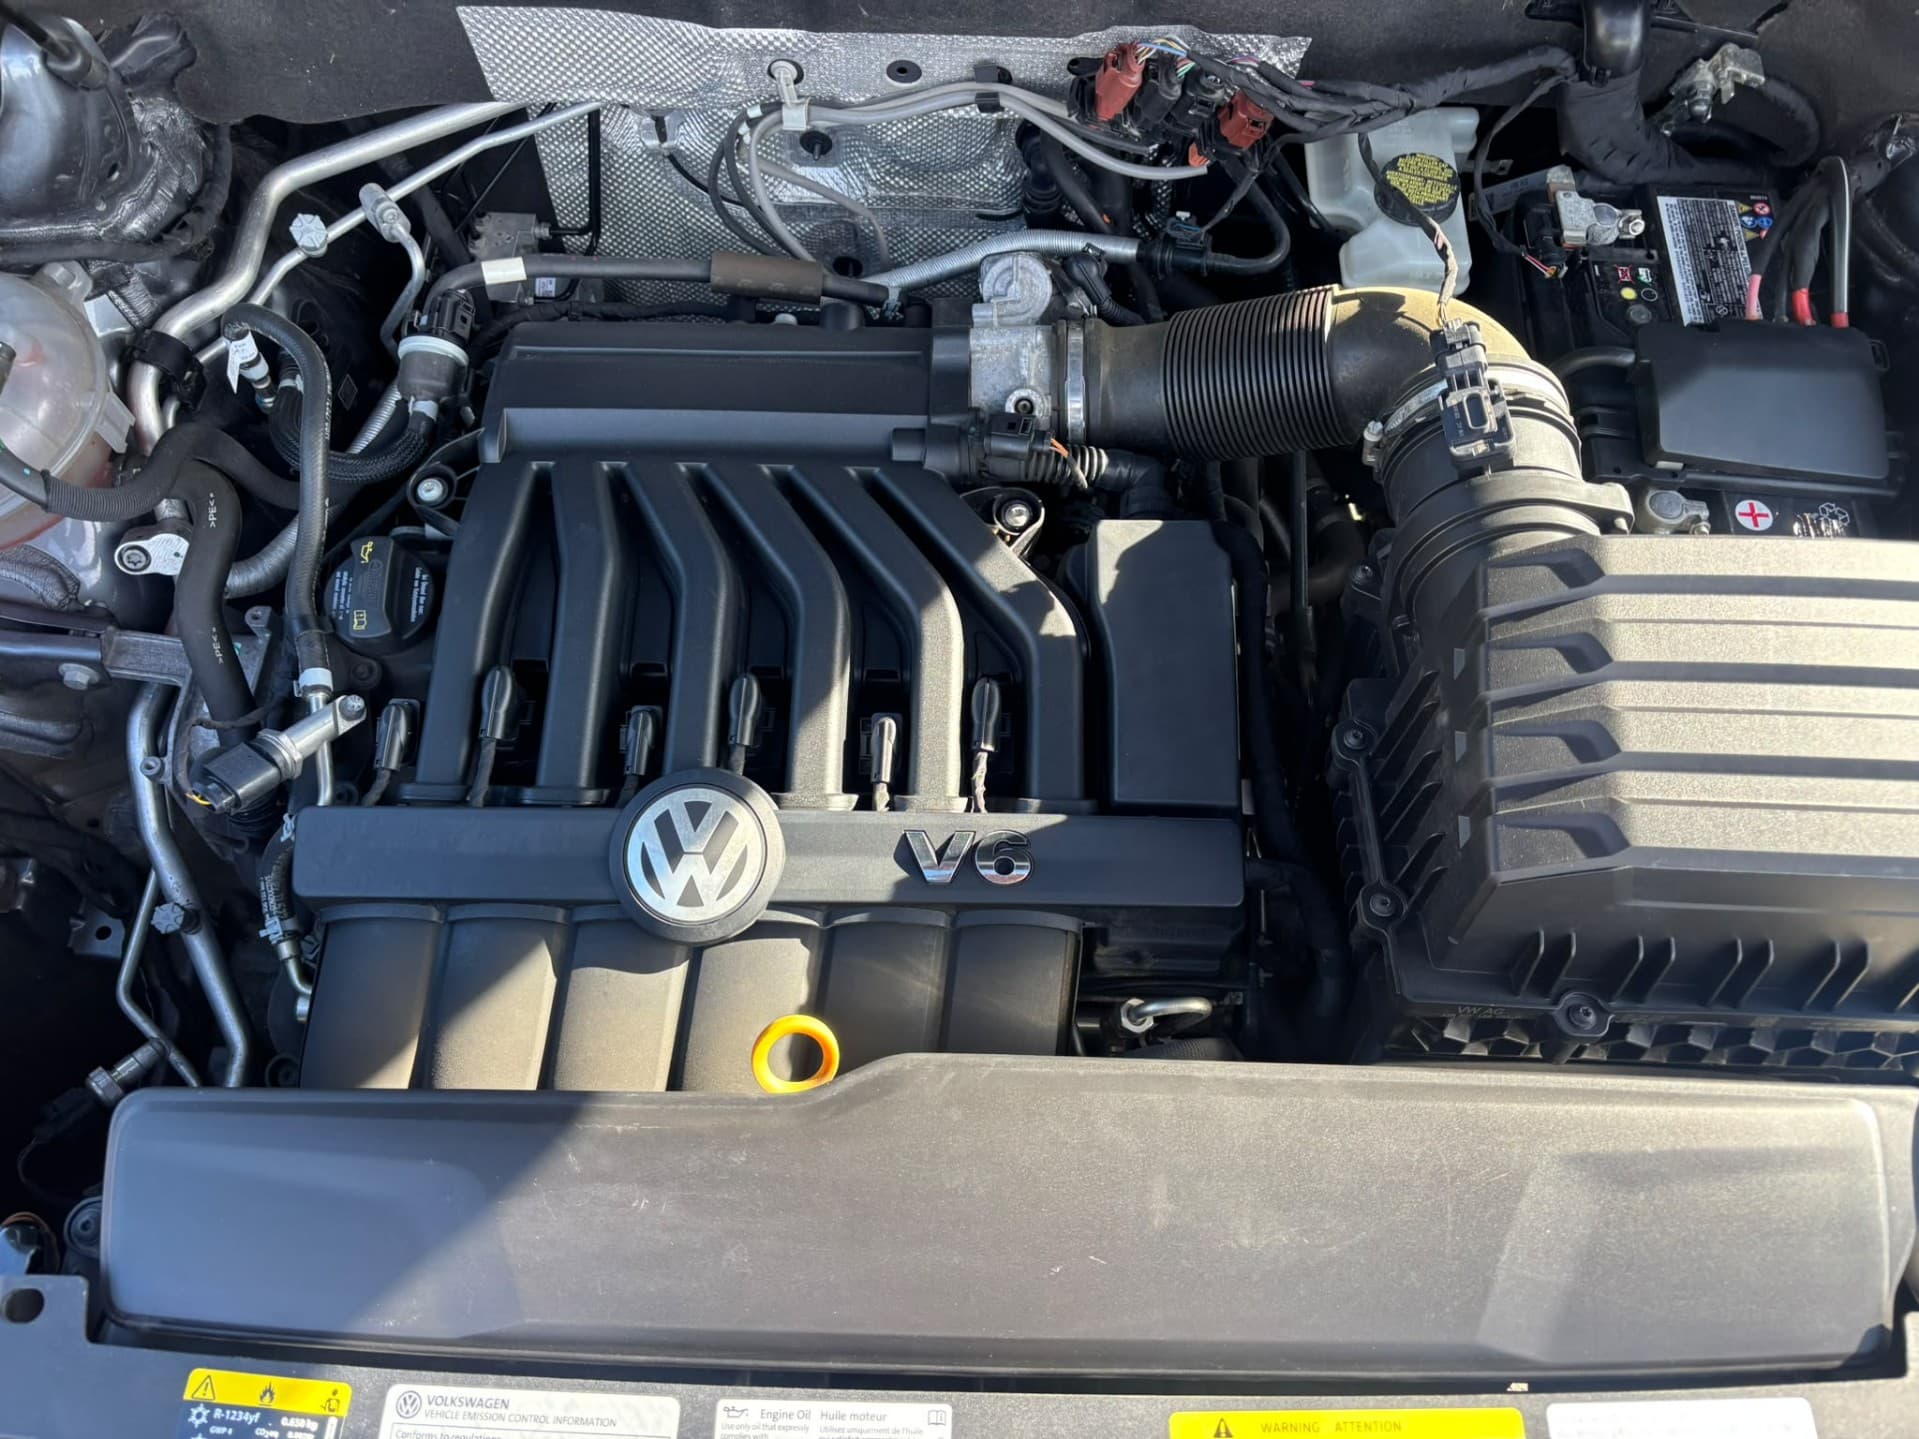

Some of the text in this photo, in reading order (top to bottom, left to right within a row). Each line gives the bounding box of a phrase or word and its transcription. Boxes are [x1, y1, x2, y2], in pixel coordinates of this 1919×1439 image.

[902, 829, 1035, 885] V6
[427, 1394, 510, 1410] VOLKSWAGEN
[424, 1409, 617, 1427] VEHICLE EMISSION CONTROL INFORMATION
[760, 1408, 887, 1422] Engine Oil Huile moteur
[1260, 1420, 1402, 1433] WARNING ATTENTION
